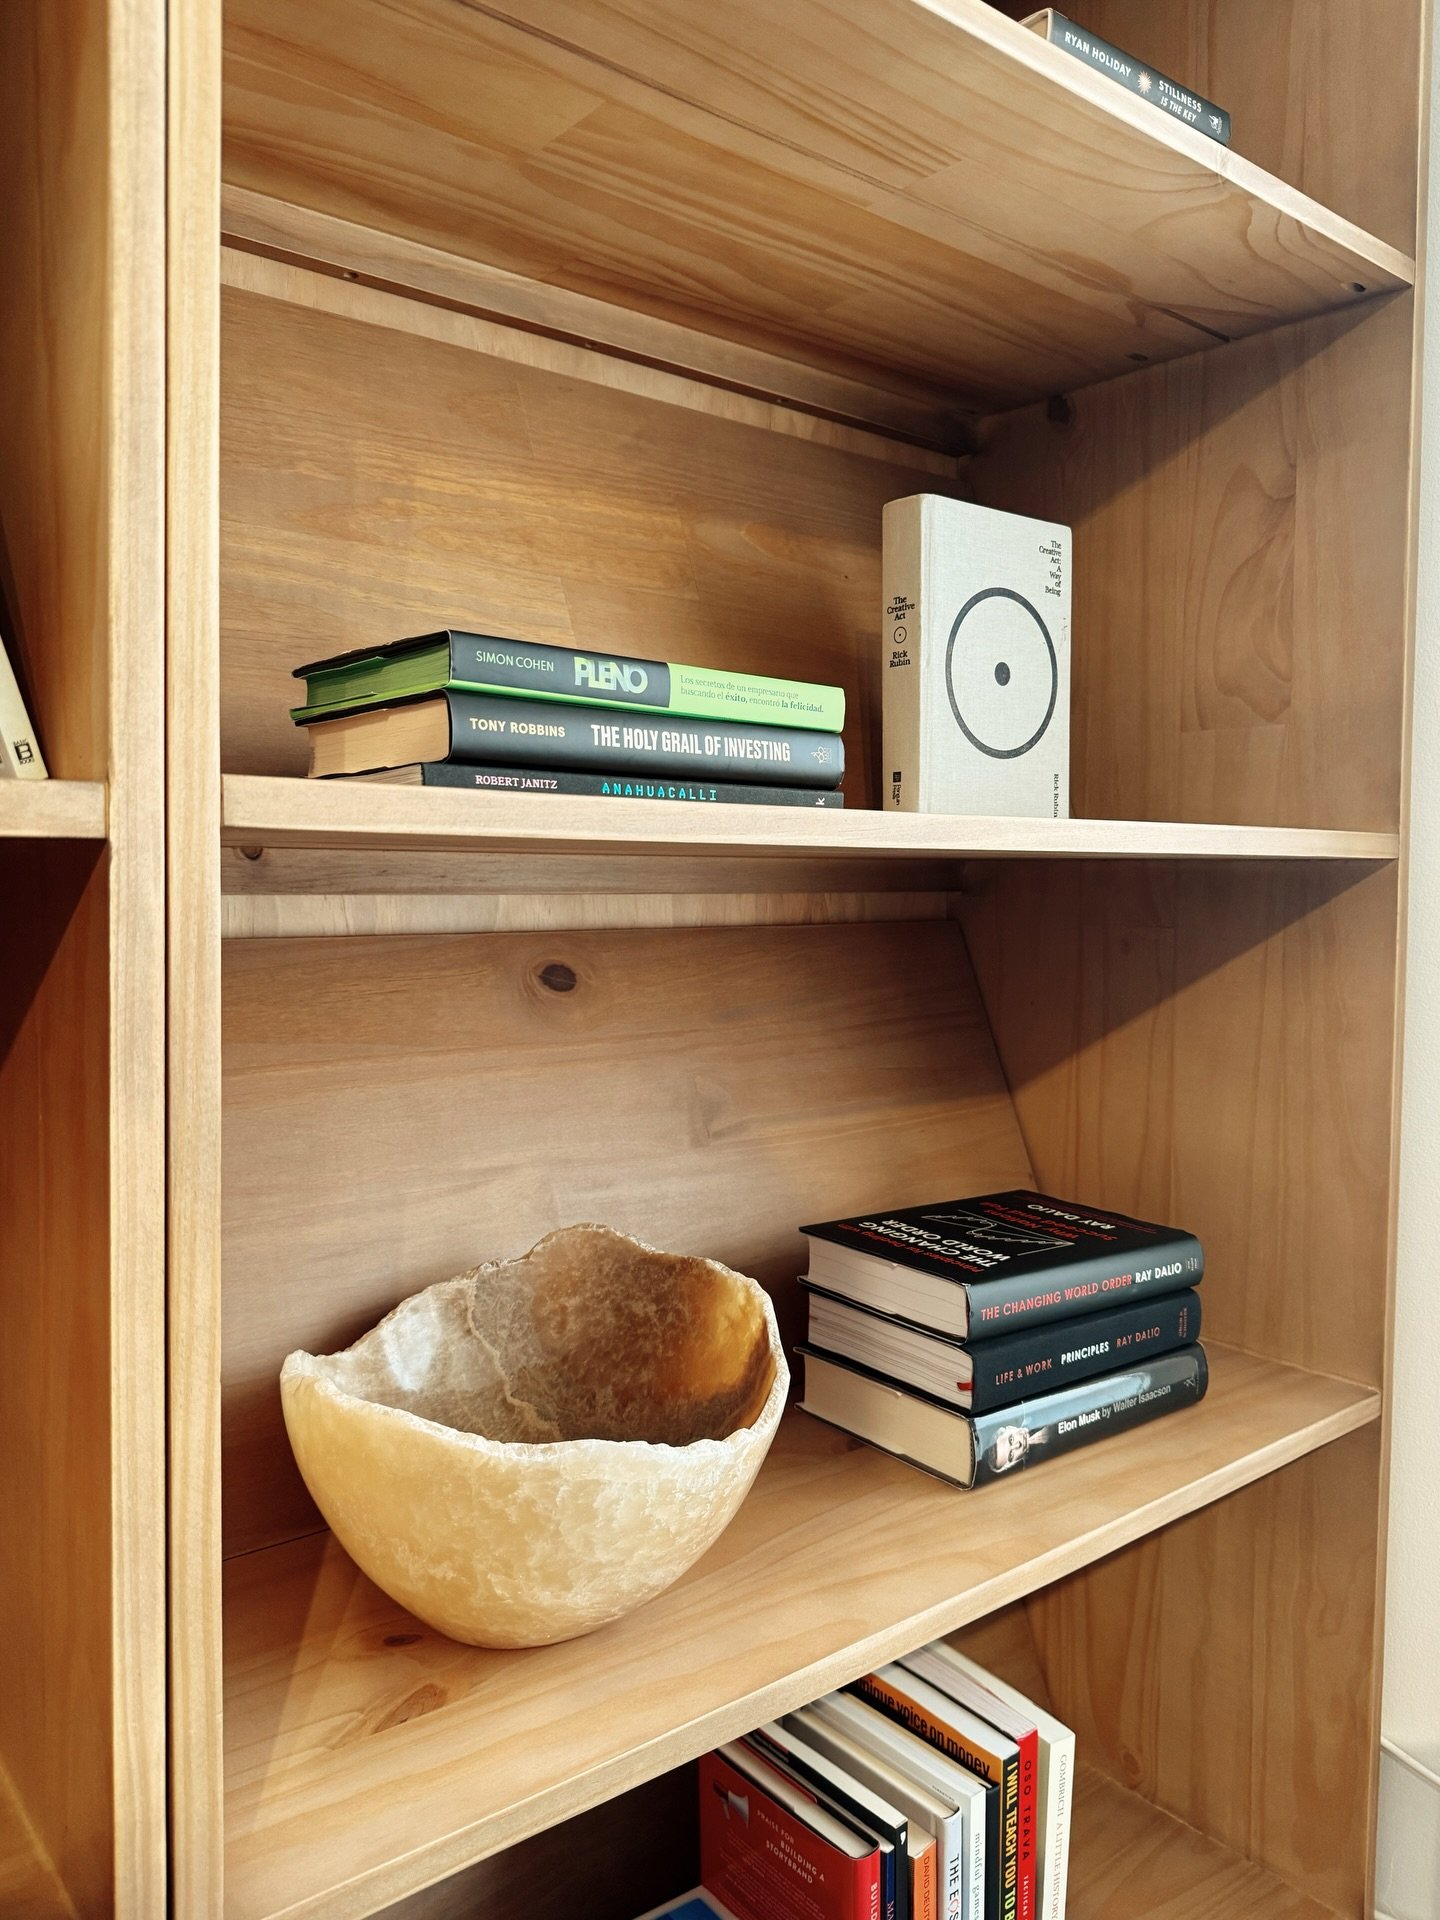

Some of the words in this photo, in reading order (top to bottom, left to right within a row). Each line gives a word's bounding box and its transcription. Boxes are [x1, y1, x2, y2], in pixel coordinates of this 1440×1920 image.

[1064, 32, 1089, 54] RYAN
[1092, 48, 1132, 77] HOLIDAY
[1159, 80, 1202, 113] STILLNESS
[1160, 96, 1168, 106] IS
[1169, 99, 1183, 115] THE
[1183, 110, 1197, 123] KEY
[1039, 546, 1062, 557] Creative
[1051, 540, 1062, 549] The
[1049, 571, 1061, 581] Way
[893, 596, 907, 605] The
[1045, 586, 1061, 597] Being
[887, 603, 915, 614] Creative
[894, 612, 906, 621] Act
[476, 651, 514, 666] SIMON
[515, 657, 554, 672] COHEN
[889, 658, 911, 668] Rubin
[892, 650, 908, 659] Rick
[573, 656, 648, 694] PLENO
[680, 675, 694, 684] Los
[695, 678, 725, 689] secretos
[726, 682, 735, 690] de
[747, 686, 785, 698] empresario
[786, 691, 799, 700] que
[681, 685, 715, 698] buscando
[716, 691, 724, 700] el
[725, 692, 748, 704] éxito,
[749, 696, 780, 707] encontró
[781, 699, 789, 708] la
[790, 700, 824, 713] felicidad.
[469, 718, 506, 732] TONY
[510, 721, 565, 738] ROBBINS
[591, 724, 620, 748] THE
[623, 727, 658, 750] HOLY
[662, 731, 702, 754] GRAIL
[705, 735, 721, 756] OF
[724, 737, 791, 762] INVESTING
[475, 775, 519, 787] ROBERT
[521, 778, 557, 790] JANITZ
[602, 782, 716, 801] ANAHUACALLI
[1027, 1204, 1080, 1220] DALIO
[881, 1219, 941, 1240] ORDER
[1079, 1220, 1117, 1230] RAY
[858, 1222, 960, 1255] CHANGING
[942, 1239, 1011, 1261] WORLD
[959, 1254, 998, 1267] THE
[1135, 1270, 1152, 1284] RAY
[1154, 1262, 1182, 1279] DALIO
[981, 1308, 999, 1321] THE
[1003, 1292, 1061, 1316] CHANGING
[1064, 1282, 1098, 1299] WORLD
[1101, 1274, 1132, 1291] ORDER
[1116, 1334, 1132, 1348] RAY
[1135, 1327, 1161, 1343] DALIO
[1061, 1341, 1110, 1365] PRINCIPLES
[995, 1370, 1014, 1385] LIFE
[1017, 1368, 1023, 1378] &
[1025, 1359, 1052, 1375] WORK
[1058, 1419, 1077, 1434] Elon
[1078, 1411, 1101, 1427] Musk
[1101, 1407, 1112, 1418] by
[1112, 1398, 1137, 1413] Walter
[1138, 1385, 1171, 1404] Isaacson
[896, 1701, 928, 1735] voice
[929, 1723, 945, 1747] on
[946, 1736, 990, 1777] money
[1007, 1761, 1018, 1770] I
[1023, 1760, 1031, 1795] OSO
[1006, 1769, 1017, 1809] WILL
[1057, 1754, 1067, 1817] GOMBRICH
[757, 1809, 779, 1833] PRAISE
[781, 1829, 795, 1844] FOR
[1005, 1807, 1017, 1857] TEACH
[1022, 1806, 1031, 1860] TRAVA
[1056, 1822, 1064, 1831] A
[766, 1839, 813, 1884] STORYBRAND
[781, 1840, 817, 1875] BUILDING
[819, 1873, 825, 1882] A
[974, 1833, 983, 1881] mindful
[1053, 1832, 1063, 1871] LITTLE
[949, 1853, 960, 1887] THE
[1004, 1856, 1016, 1889] YOU
[1004, 1887, 1015, 1910] TO
[1051, 1871, 1061, 1919] HISTORY
